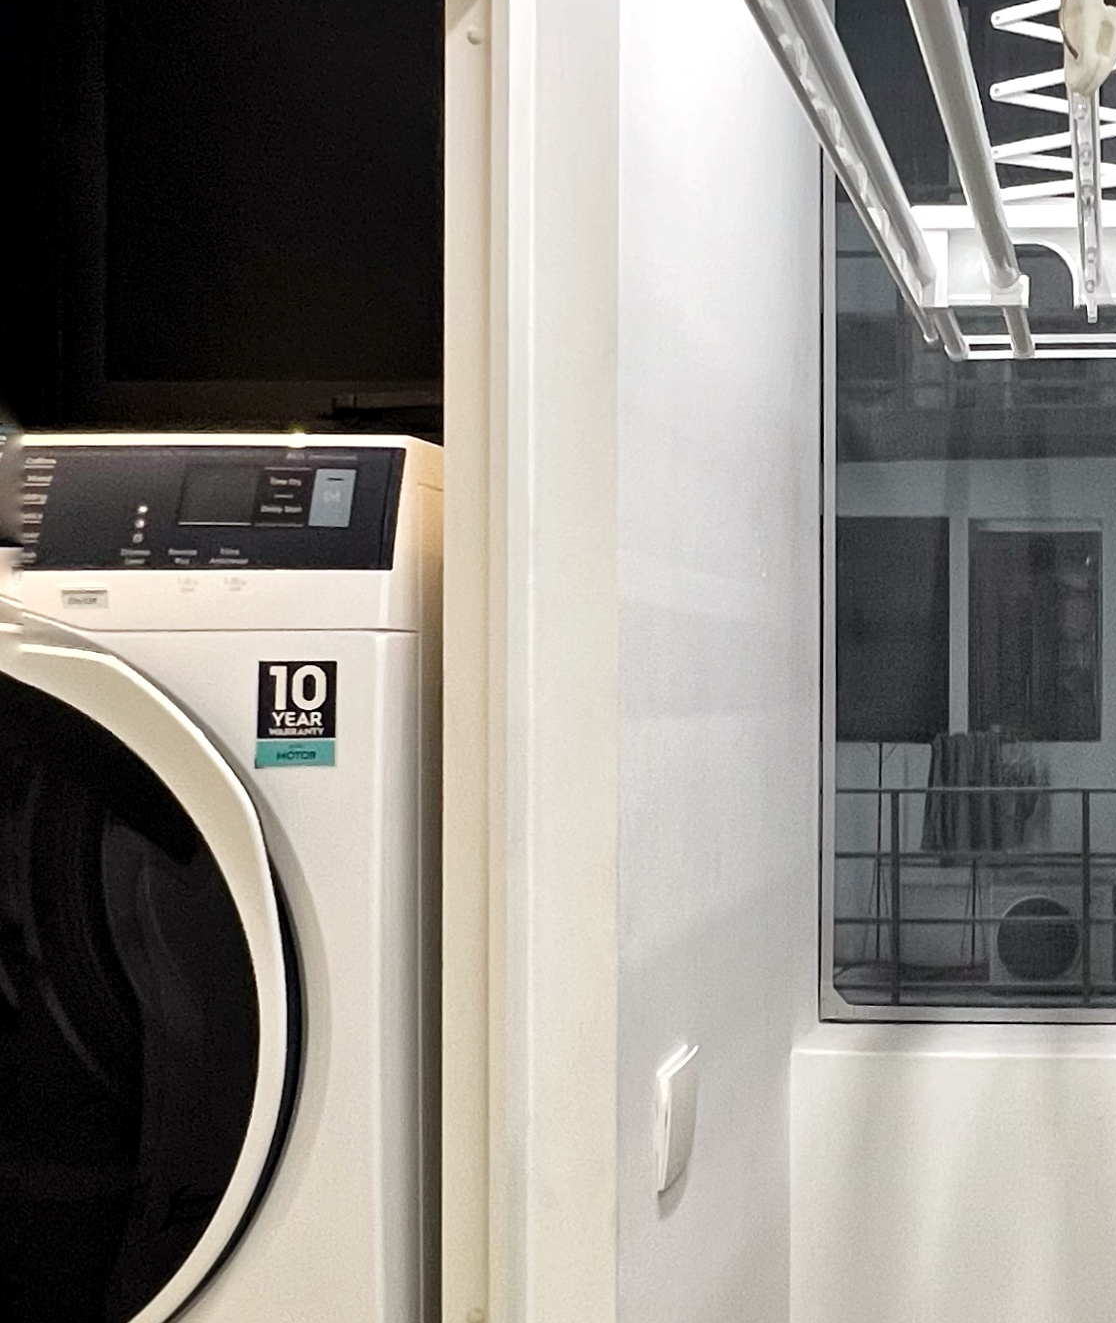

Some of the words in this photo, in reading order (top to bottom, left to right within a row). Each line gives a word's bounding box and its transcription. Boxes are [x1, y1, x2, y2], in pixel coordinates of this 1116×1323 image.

[269, 664, 327, 711] 10
[272, 711, 323, 727] YEAR
[268, 727, 325, 736] WARRANTY
[277, 751, 317, 760] MOTOR
